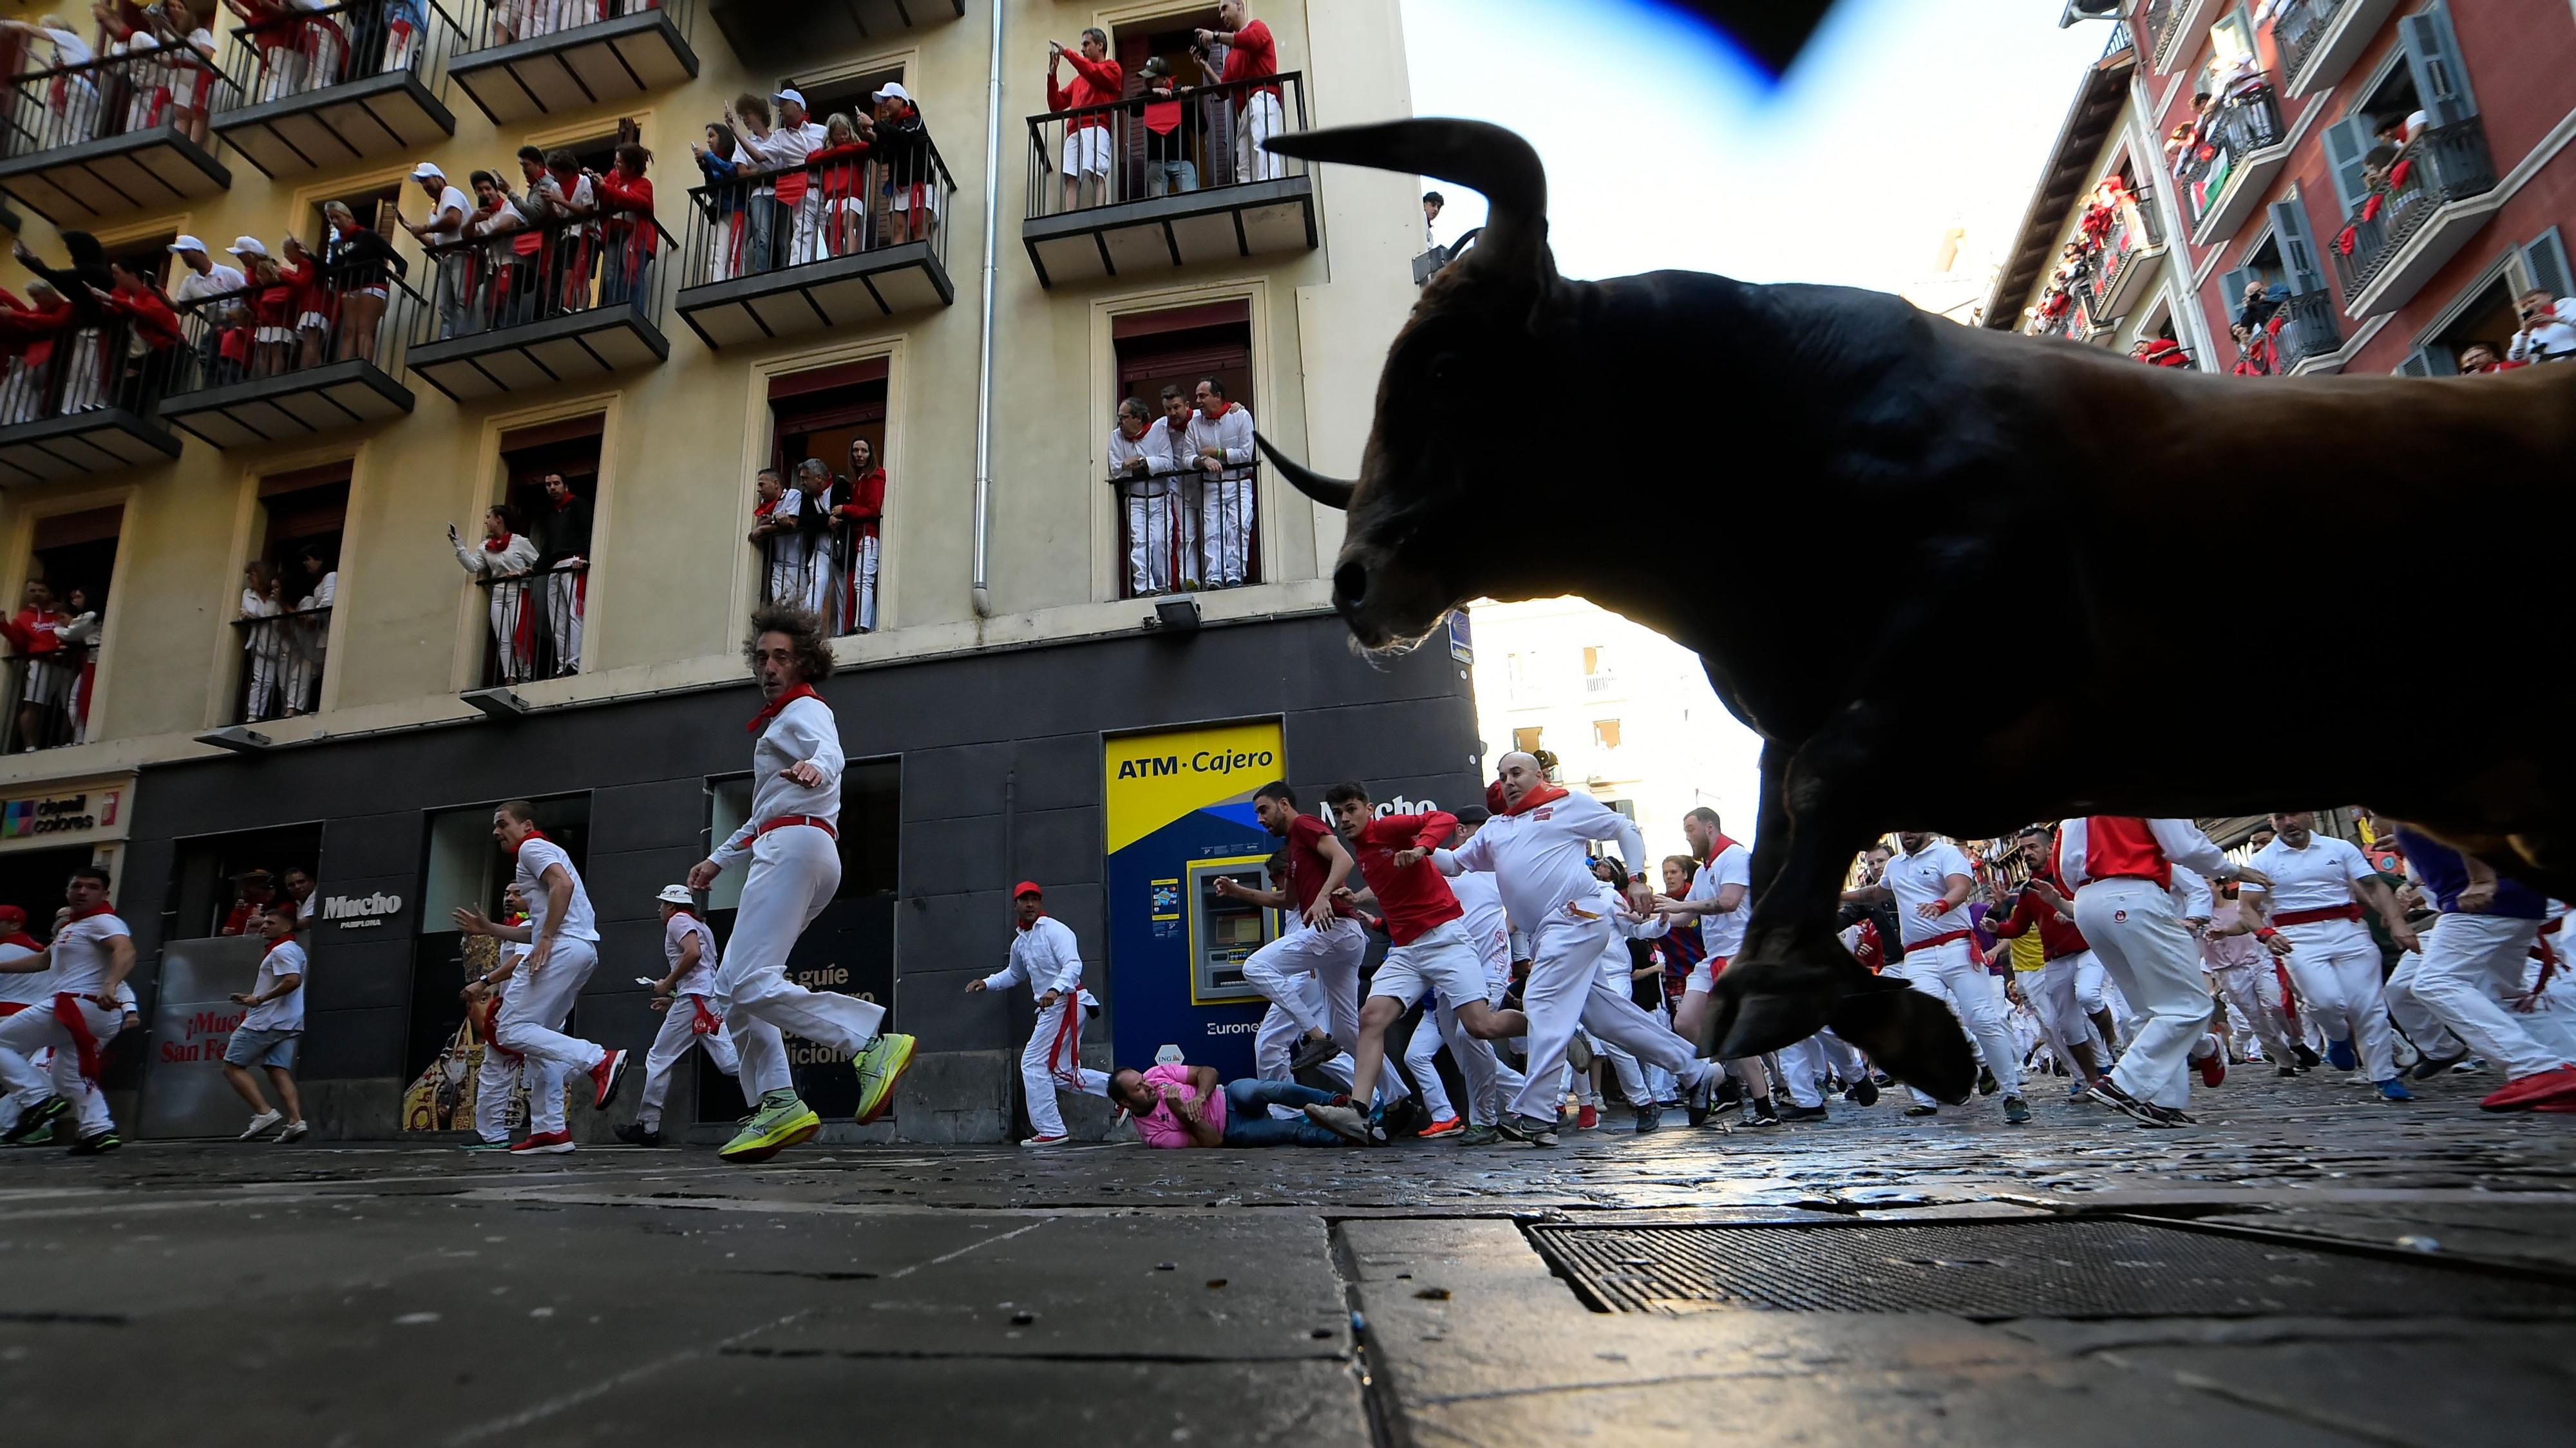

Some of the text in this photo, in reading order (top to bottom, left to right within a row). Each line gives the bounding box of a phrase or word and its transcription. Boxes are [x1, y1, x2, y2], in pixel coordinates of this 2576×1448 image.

[1118, 749, 1273, 780] ATM Cajero
[35, 814, 93, 832] colores
[323, 892, 401, 919] Mucho
[340, 919, 381, 929] PAMPLONA
[799, 963, 849, 990] guíe
[161, 1040, 198, 1062] San
